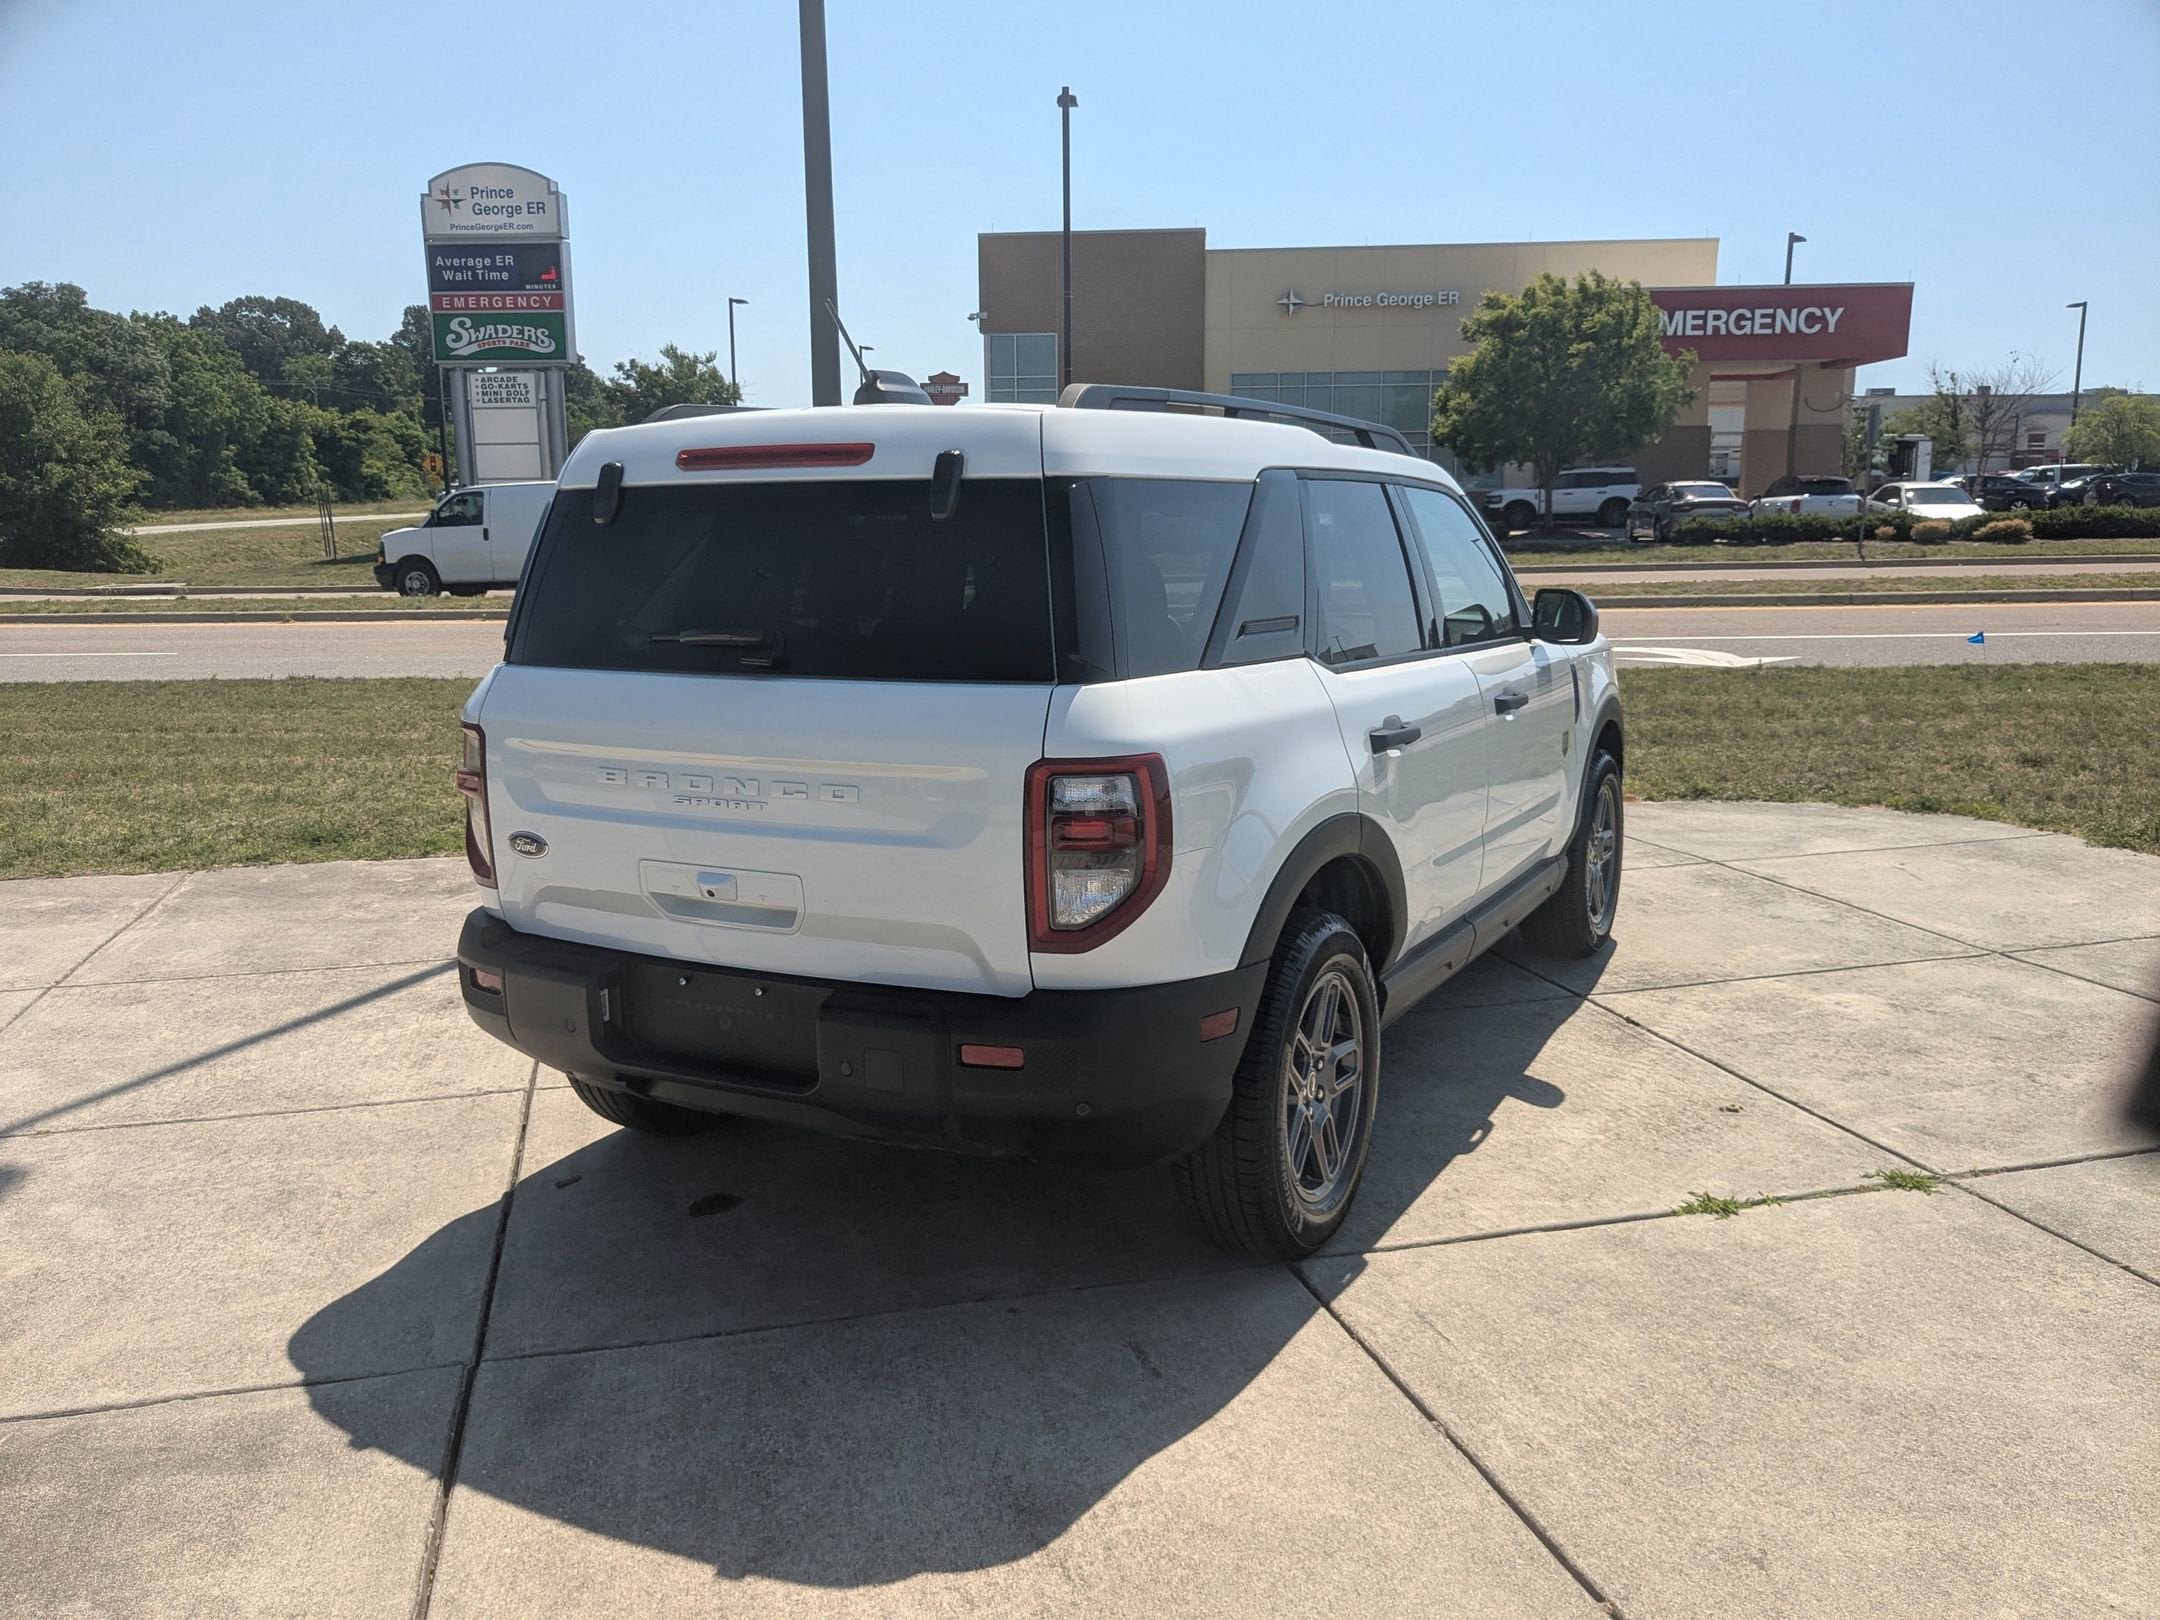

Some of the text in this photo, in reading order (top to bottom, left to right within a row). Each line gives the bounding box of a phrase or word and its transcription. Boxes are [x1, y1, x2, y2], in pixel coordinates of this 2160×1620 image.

[470, 186, 514, 199] Prince
[472, 201, 546, 218] George ER
[450, 223, 534, 232] PrinceGeorgeER.com
[435, 255, 514, 268] Average ER
[442, 270, 509, 281] Wait Time
[442, 296, 552, 309] EMERGENCY
[1323, 291, 1459, 309] Prince George ER
[1659, 307, 1844, 336] MERGENCY
[445, 317, 551, 349] SWADERS
[477, 339, 530, 349] SPORTS PARK
[506, 389, 530, 397] GOLF
[597, 768, 859, 803] BRONCO
[672, 795, 769, 811] SPORT
[515, 836, 537, 853] Ford
